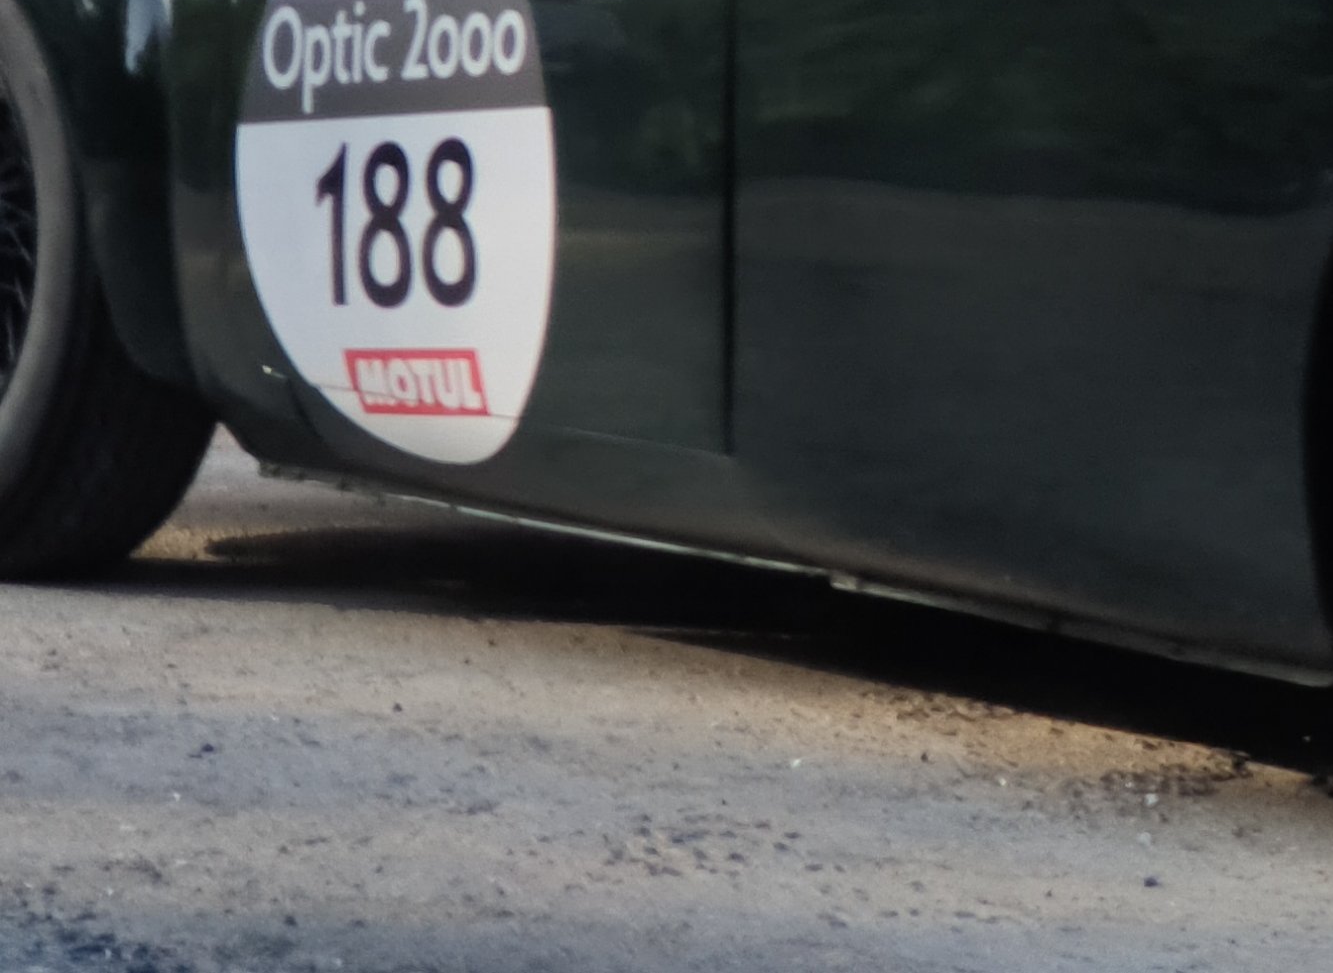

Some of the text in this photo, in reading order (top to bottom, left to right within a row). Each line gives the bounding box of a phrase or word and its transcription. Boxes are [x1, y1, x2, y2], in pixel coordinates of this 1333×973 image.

[263, 0, 392, 115] Optic
[315, 136, 477, 309] 188
[354, 357, 483, 410] MOTUL
